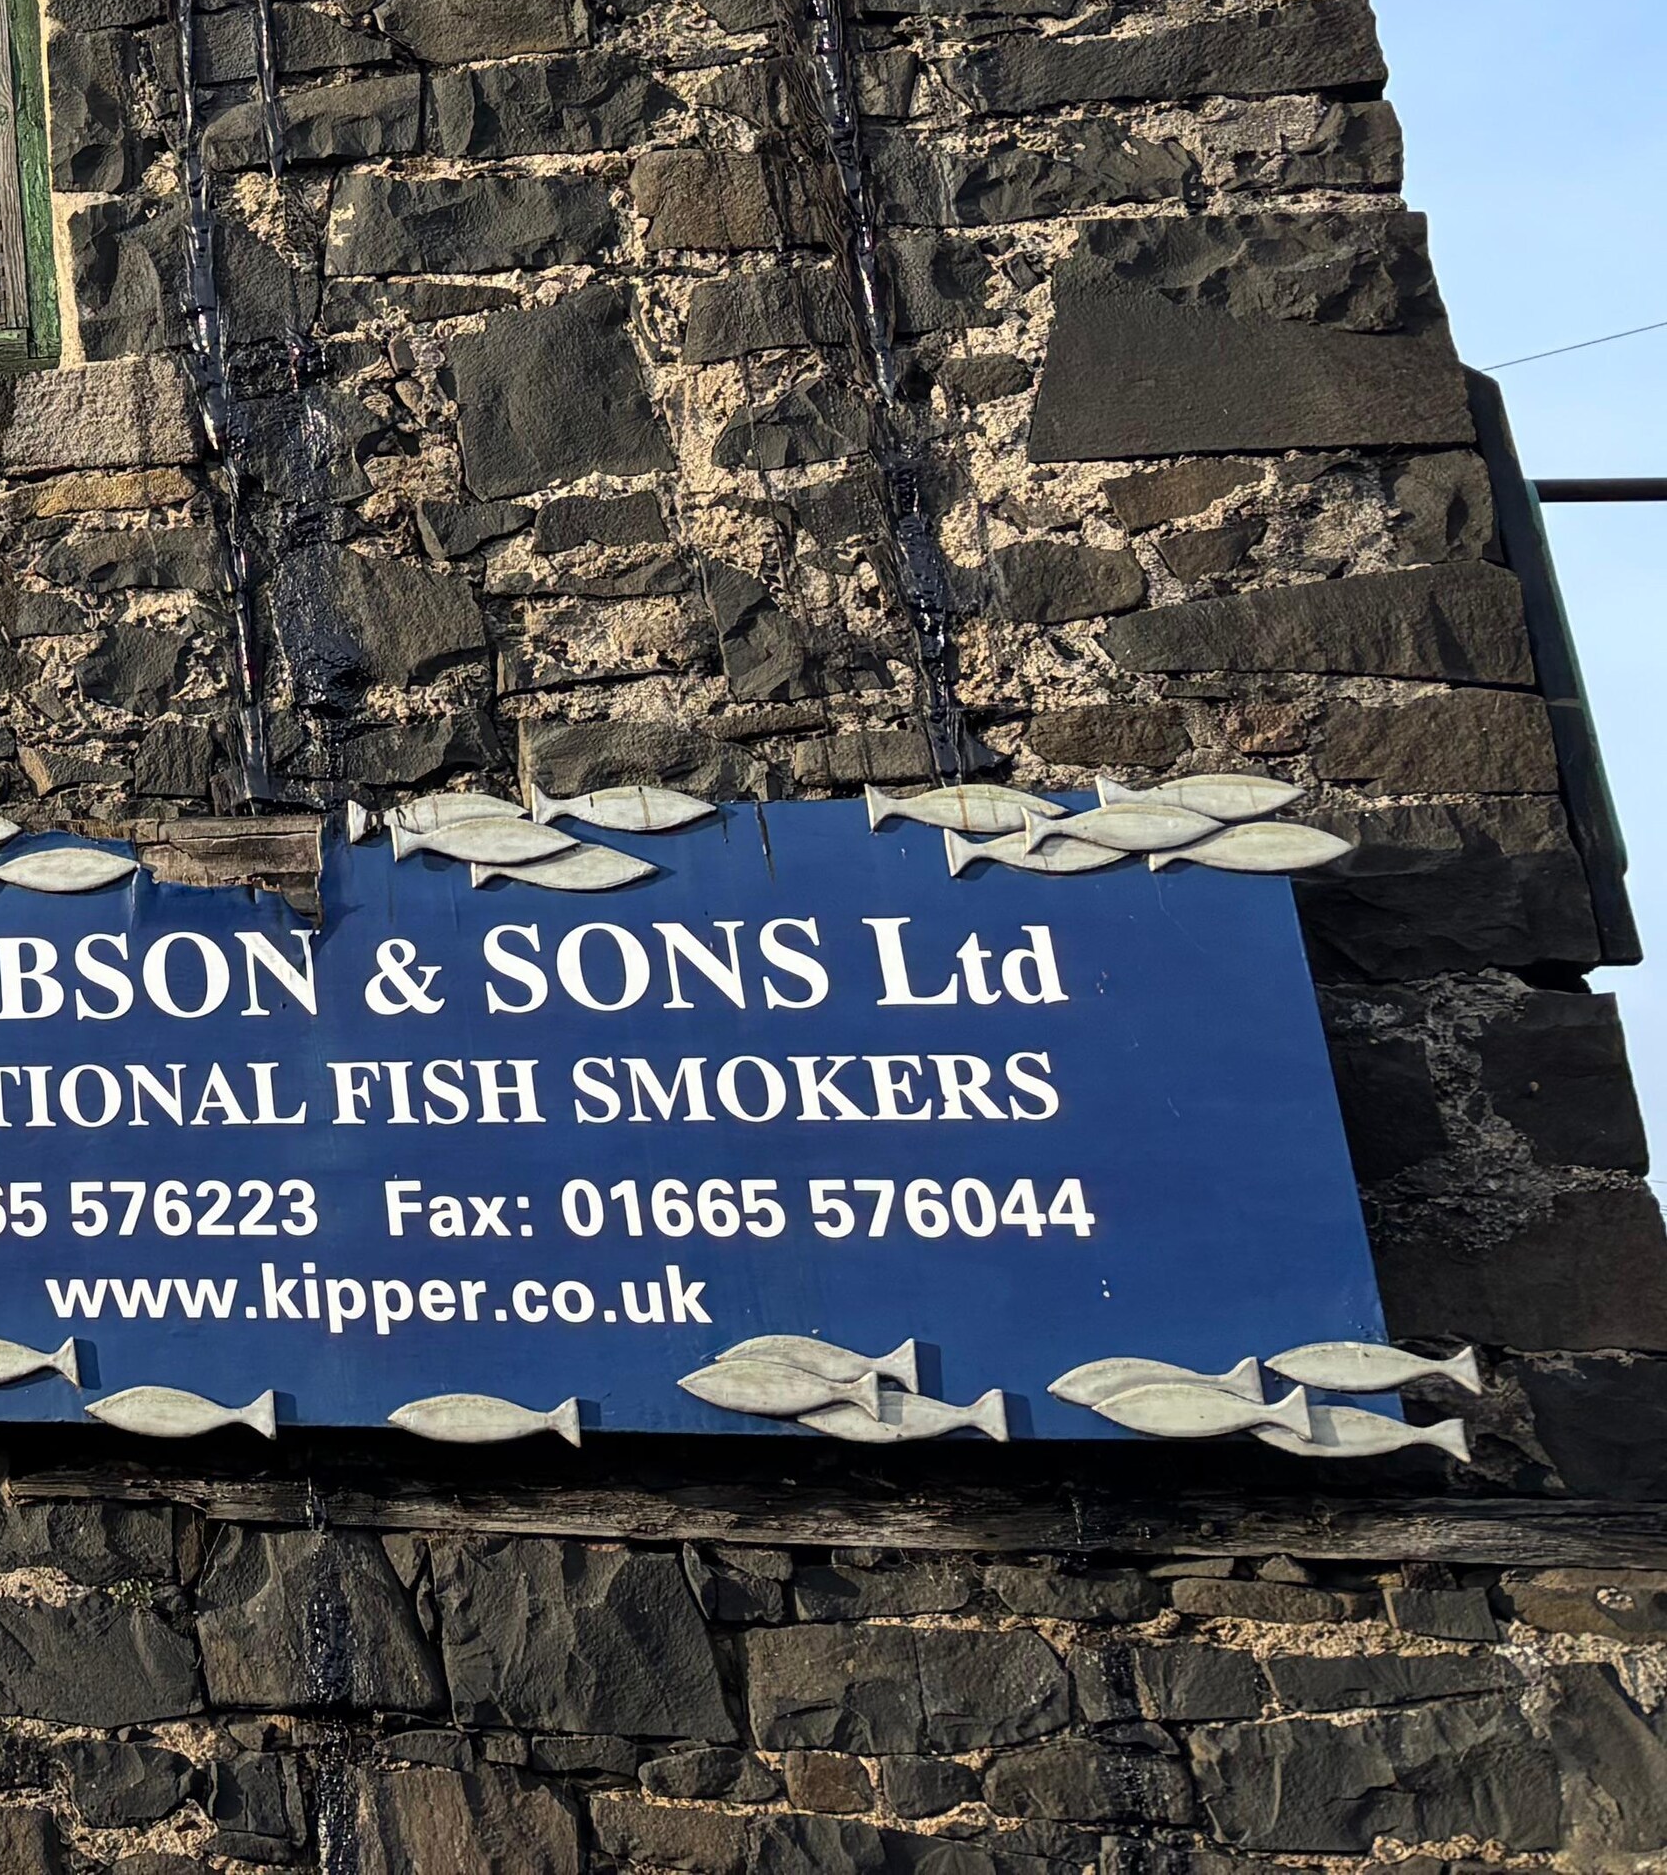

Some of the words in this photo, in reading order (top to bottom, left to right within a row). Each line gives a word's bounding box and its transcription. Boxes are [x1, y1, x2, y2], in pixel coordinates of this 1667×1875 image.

[364, 938, 446, 1016] &
[483, 916, 829, 1014] SONS
[861, 917, 1070, 1006] Ltd
[326, 1059, 547, 1125] FISH
[572, 1051, 1059, 1124] SMOKERS
[70, 1179, 318, 1237] 576223
[384, 1180, 533, 1238] Fax:
[561, 1178, 786, 1238] 01665
[808, 1177, 1096, 1239] 576044
[44, 1262, 713, 1335] www.kipper.co.uk
